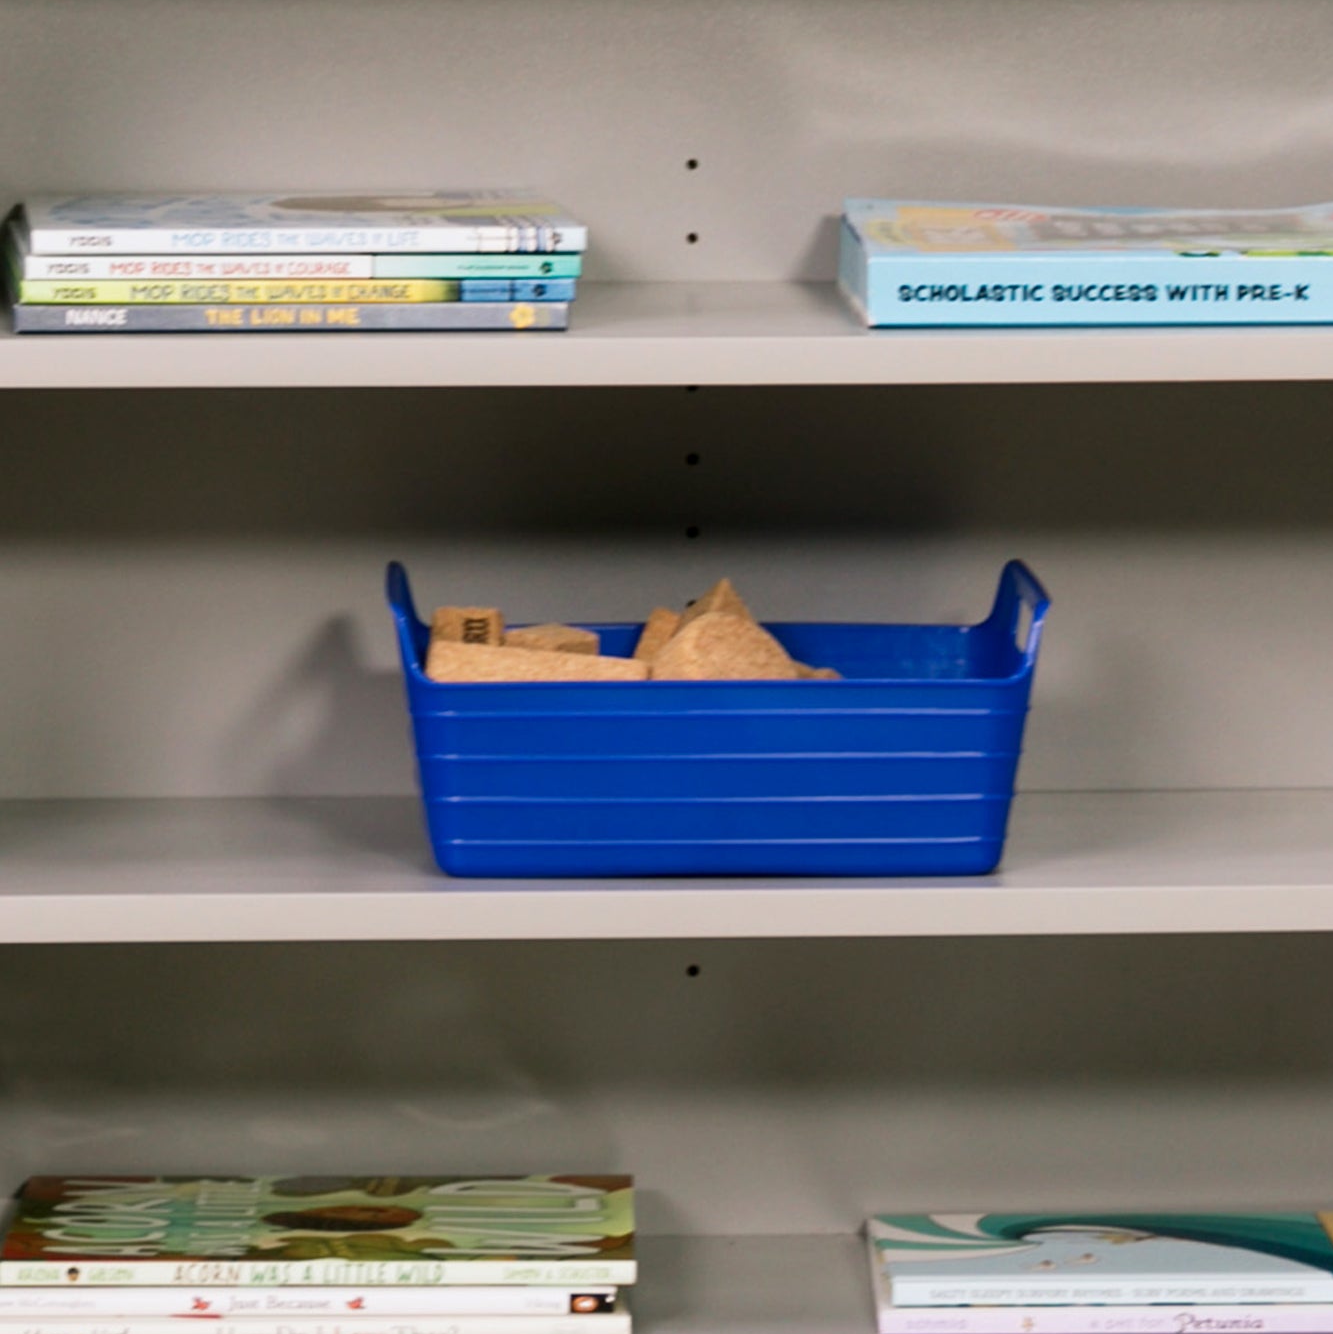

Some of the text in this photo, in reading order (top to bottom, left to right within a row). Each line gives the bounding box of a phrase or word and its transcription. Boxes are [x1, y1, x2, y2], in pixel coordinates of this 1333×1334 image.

[221, 232, 271, 247] RIDES
[387, 231, 420, 246] LIFE
[109, 262, 145, 275] MOP
[151, 262, 192, 276] RIDES
[221, 262, 270, 275] WAVES
[287, 262, 351, 275] COURAGE
[130, 285, 175, 300] MOP
[181, 284, 231, 302] RIDES
[266, 285, 327, 300] WAVES
[346, 284, 414, 299] CHANGE
[898, 283, 1311, 302] SCHOLASTIC SUCCESS WITH PRE-K
[205, 307, 361, 325] THE LION IN ME
